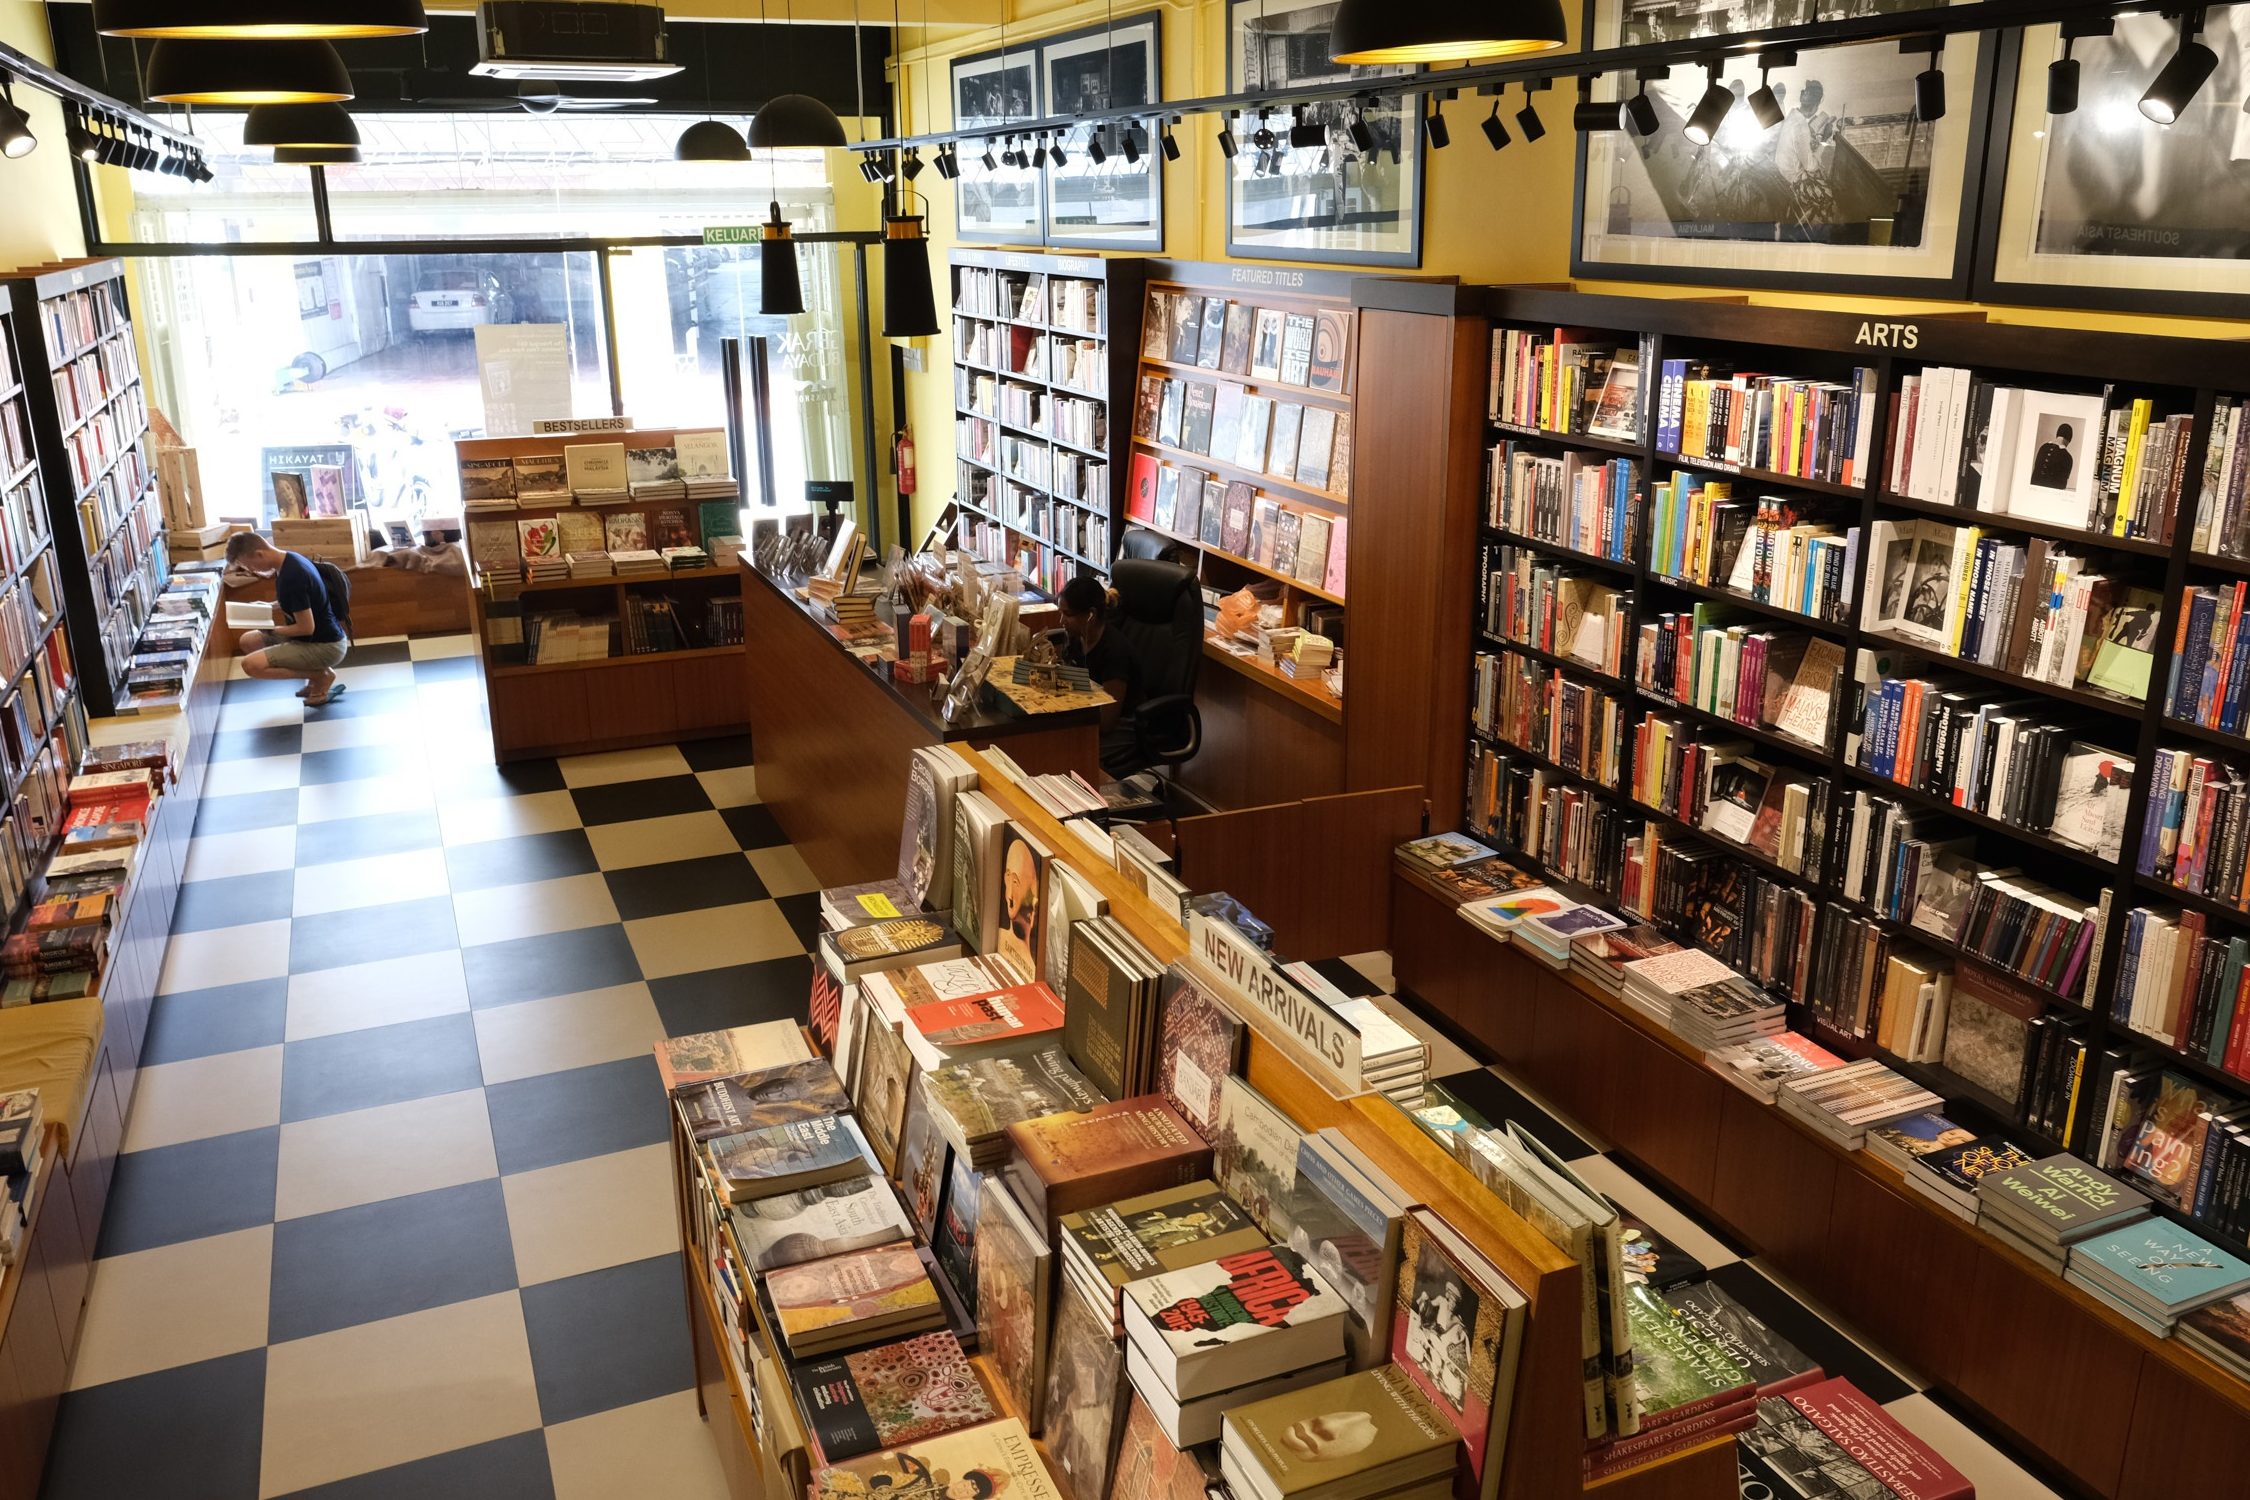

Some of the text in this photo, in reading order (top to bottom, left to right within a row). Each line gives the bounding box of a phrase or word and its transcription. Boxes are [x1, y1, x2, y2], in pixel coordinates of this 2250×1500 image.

[706, 228, 756, 242] KELUAR
[1005, 255, 1030, 268] LIFESTYLE
[1057, 258, 1089, 272] BIOGRAPHY
[1231, 267, 1304, 287] FEATURED TITLES
[1286, 316, 1313, 328] THE
[1855, 322, 1918, 349] ARTS
[1659, 376, 1672, 428] CINEMA
[1670, 375, 1683, 428] CINEMA
[543, 419, 625, 432] BESTSELLERS
[269, 454, 324, 465] HIKAYAT
[1678, 454, 1740, 473] FILM, TELEVISION AND DRAMA
[2100, 436, 2116, 492] MAGNUM
[2109, 437, 2127, 494] MAGNUM
[1754, 528, 1765, 571] MOTOWN
[1766, 530, 1775, 573] MOTOWN
[1660, 575, 1678, 587] MUSIC
[1832, 566, 1838, 574] OF
[1966, 548, 1983, 619] IN WHOSE NAME?
[1980, 550, 1996, 621] IN WHOSE NAME?
[2030, 618, 2040, 642] ABBOTT
[2037, 619, 2046, 644] ABBOTT
[1637, 687, 1678, 708] PERFORMING ARTS
[1475, 728, 1494, 742] TEXTILES
[1784, 709, 1821, 735] THEATRE
[1874, 718, 1883, 757] PHOTOGRAPHY
[1878, 746, 1884, 755] OF
[1885, 720, 1894, 760] PHOTOGRAPHY
[1936, 706, 1950, 774] PHOTOGRAPHY
[1890, 748, 1895, 757] OF
[2149, 755, 2163, 797] DRAWING
[2159, 758, 2173, 799] DRAWING
[1470, 826, 1487, 839] CRAFTS
[2223, 800, 2241, 879] STREET ART PENANG STYLE
[1544, 868, 1569, 884] CERAMICS
[1578, 909, 1608, 925] KIMONO
[1618, 906, 1657, 932] PHOTOGRAPHY
[971, 999, 1004, 1021] past
[987, 995, 1024, 1028] human
[1204, 927, 1345, 1069] NEW ARRIVALS
[1816, 1016, 1854, 1040] VISUAL ART
[1042, 1050, 1094, 1105] living pathways
[713, 1081, 742, 1127] BUDDHIST ART
[799, 1122, 812, 1141] East
[813, 1119, 829, 1145] Middle
[822, 1116, 836, 1131] The
[1135, 1110, 1171, 1149] MING HISTORY
[1147, 1111, 1172, 1138] SOURCES
[1152, 1107, 1189, 1145] ANNOTATED
[2130, 1141, 2183, 1180] ing?
[2193, 1141, 2202, 1159] SELF
[1300, 1147, 1315, 1163] CHESS
[1316, 1160, 1327, 1173] AND
[1327, 1171, 1344, 1190] OTHER
[2062, 1166, 2120, 1197] Andy
[2001, 1177, 2076, 1221] Weiwei
[2039, 1185, 2067, 1201] Ai
[2042, 1165, 2116, 1208] Warhol
[845, 1201, 865, 1226] South
[2107, 1243, 2173, 1284] SEEING
[2145, 1239, 2183, 1262] WAY
[2149, 1255, 2177, 1271] OF
[2172, 1243, 2218, 1268] NEW
[2200, 1246, 2213, 1256] A
[1216, 1250, 1311, 1327] AFRICA
[1685, 1300, 1723, 1333] SALGADO
[1665, 1318, 1742, 1382] GARDENS
[1371, 1369, 1439, 1440] LIVING WITH THE GODS
[1382, 1368, 1448, 1437] Neil MacGregor
[1671, 1401, 1714, 1422] GARDENS
[1603, 1416, 1717, 1463] SHAKESPEARE'S GARDENS
[1793, 1396, 1921, 1500] SEBASTIÃO SALGADO
